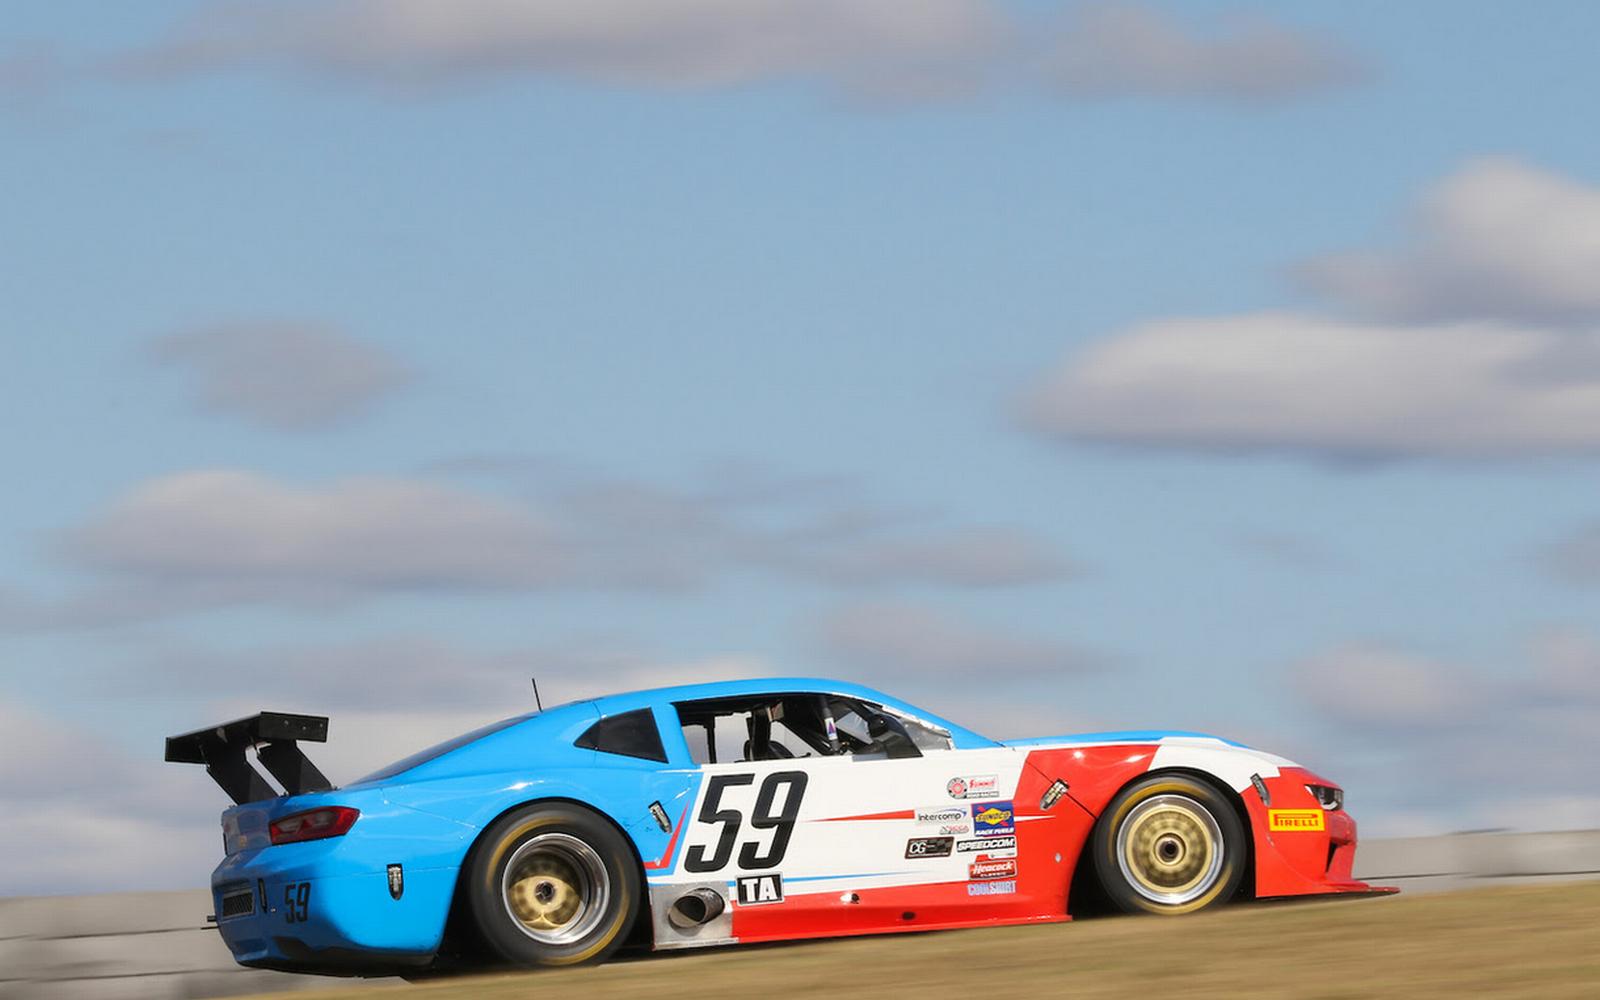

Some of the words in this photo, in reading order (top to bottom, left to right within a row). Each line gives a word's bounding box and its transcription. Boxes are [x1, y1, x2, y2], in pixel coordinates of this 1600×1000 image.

[684, 770, 808, 873] 59
[976, 810, 1011, 822] SUNOCO
[1273, 813, 1318, 826] PIRELLI
[909, 842, 927, 854] CG
[957, 838, 1015, 850] SPEEDCOM
[972, 861, 1013, 874] Heacock
[741, 876, 778, 903] TA
[284, 882, 311, 923] 59
